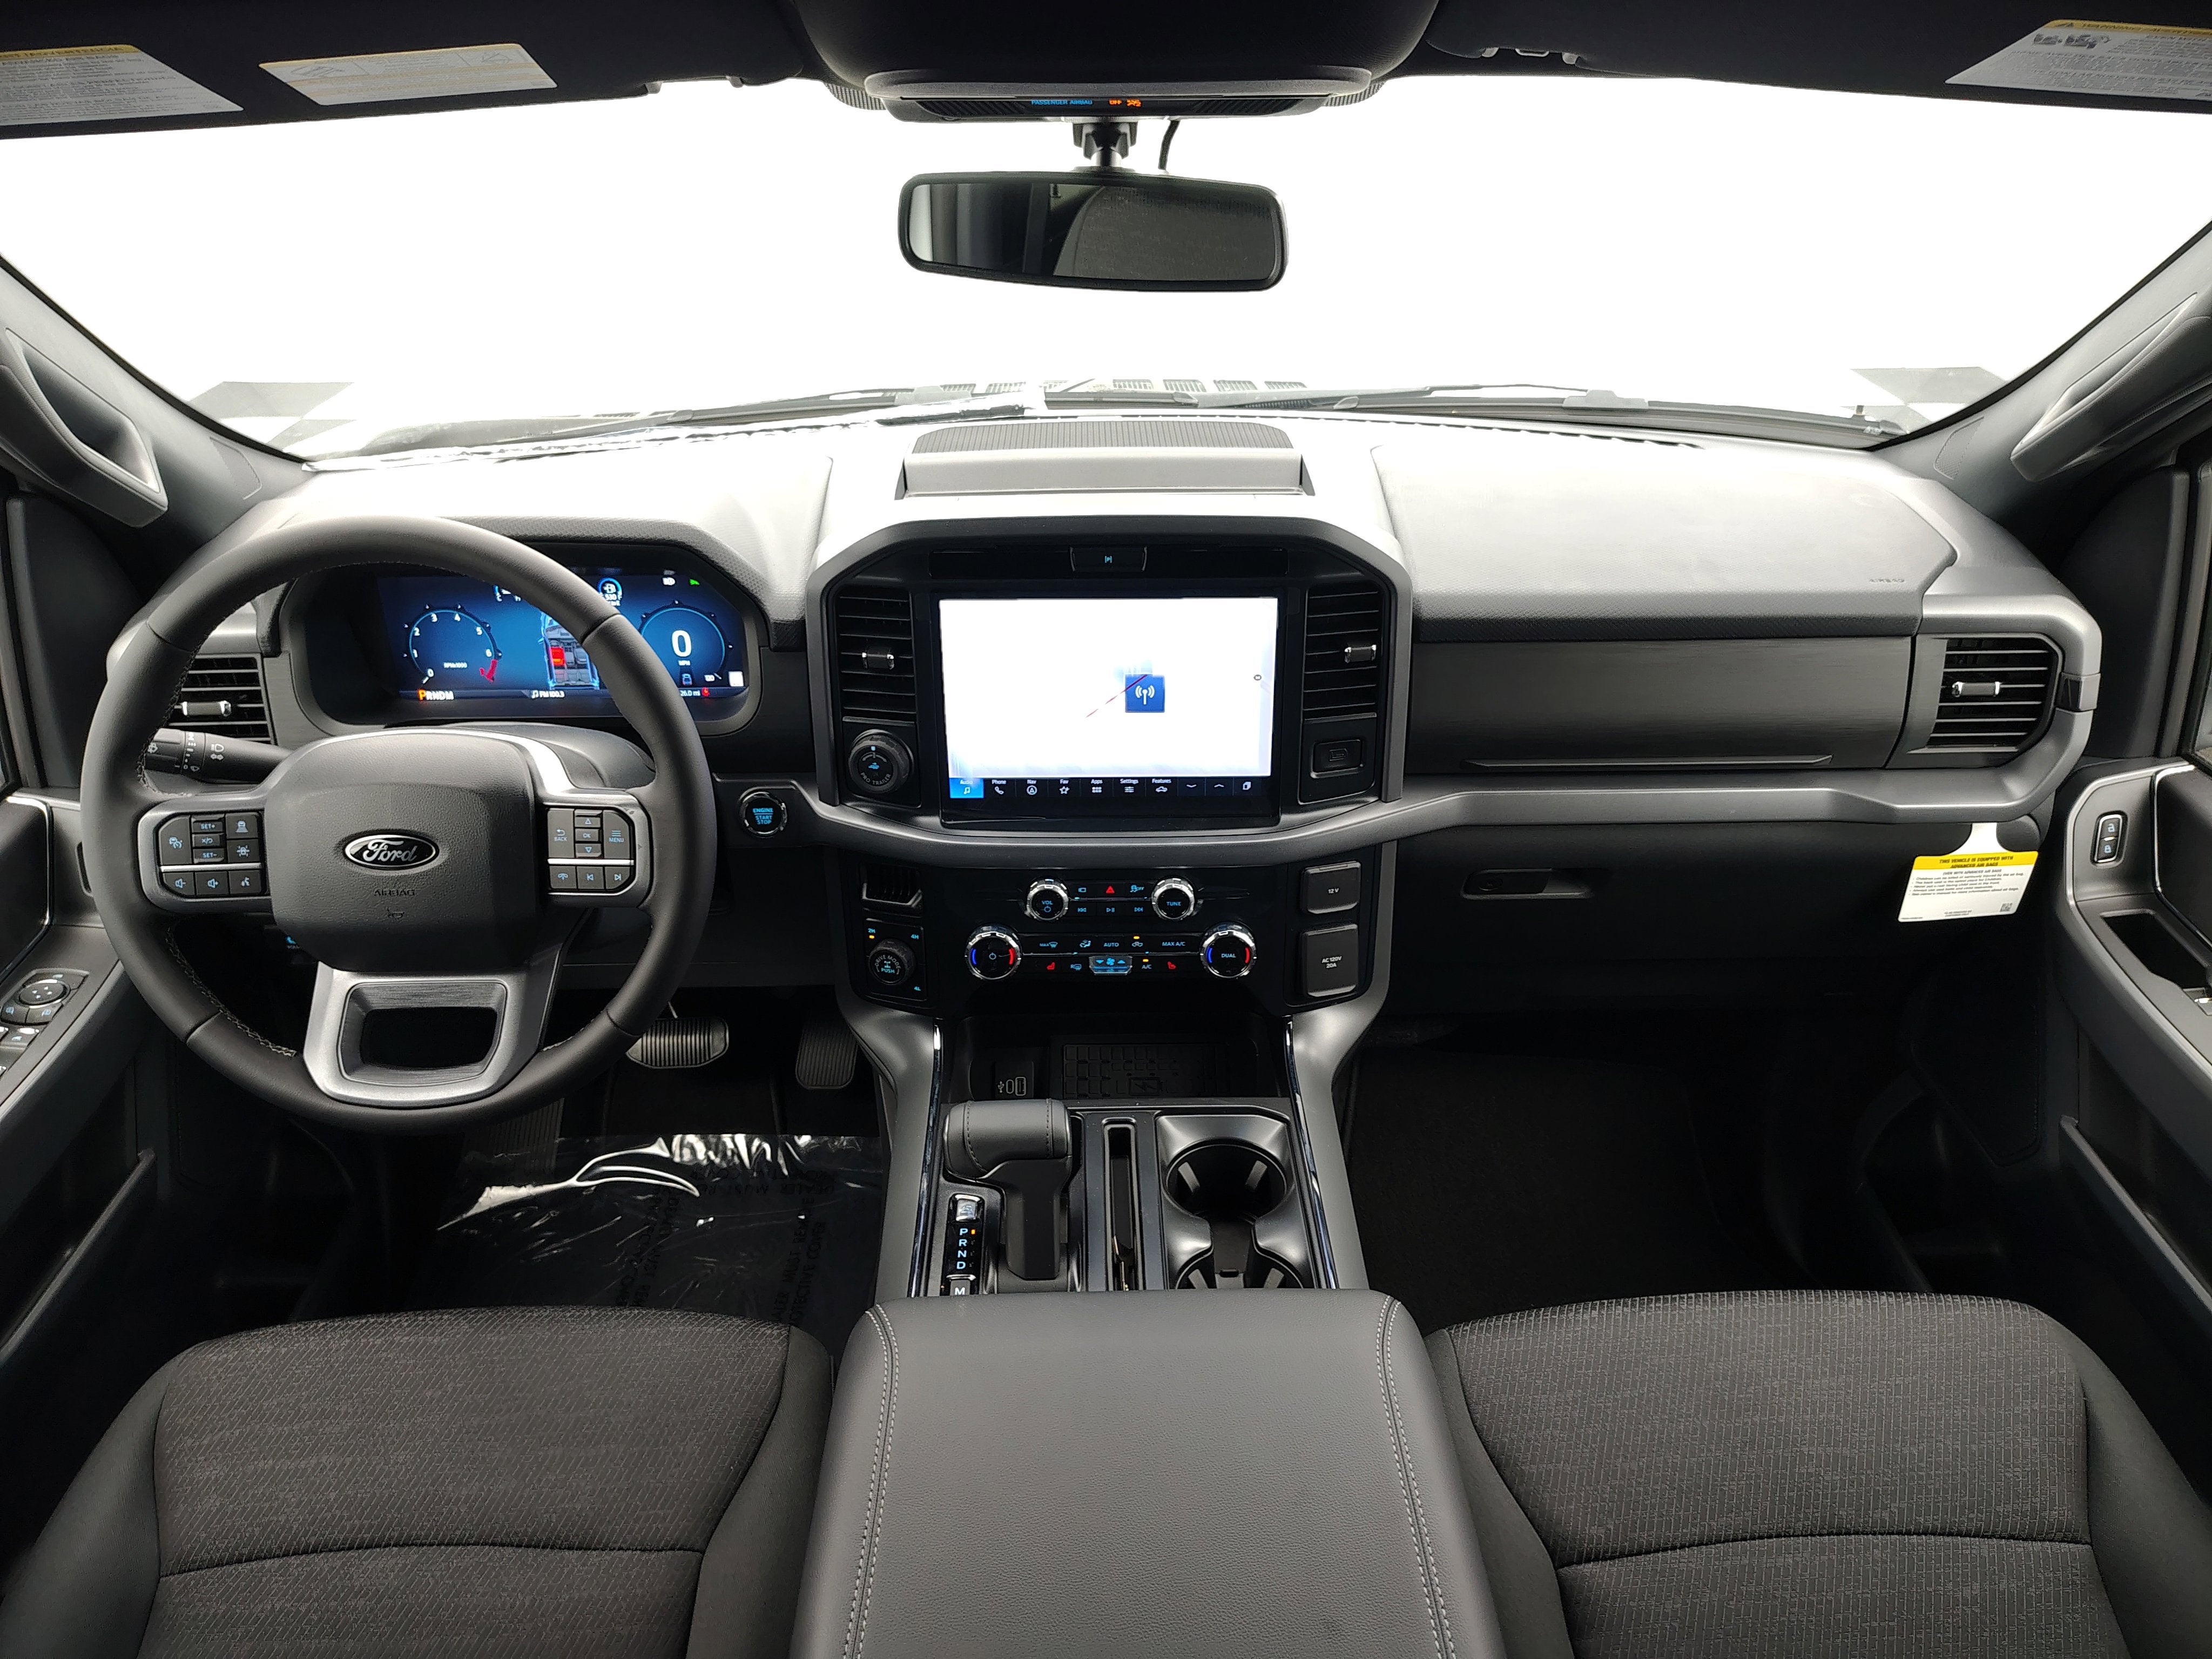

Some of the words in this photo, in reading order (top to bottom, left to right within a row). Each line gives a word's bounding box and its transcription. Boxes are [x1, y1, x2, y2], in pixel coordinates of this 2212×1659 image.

[431, 613, 437, 622] 3
[414, 628, 420, 636] 2
[476, 627, 482, 636] 5
[672, 630, 692, 657] 0
[413, 649, 418, 658] 1
[486, 649, 492, 657] 6
[428, 669, 434, 677] 0
[861, 772, 871, 783] PRO
[872, 773, 891, 785] TRAILER
[362, 839, 417, 862] Ford
[875, 955, 887, 967] DRIVE
[887, 955, 901, 969] MODE
[959, 1239, 968, 1247] R
[954, 1287, 966, 1295] M
